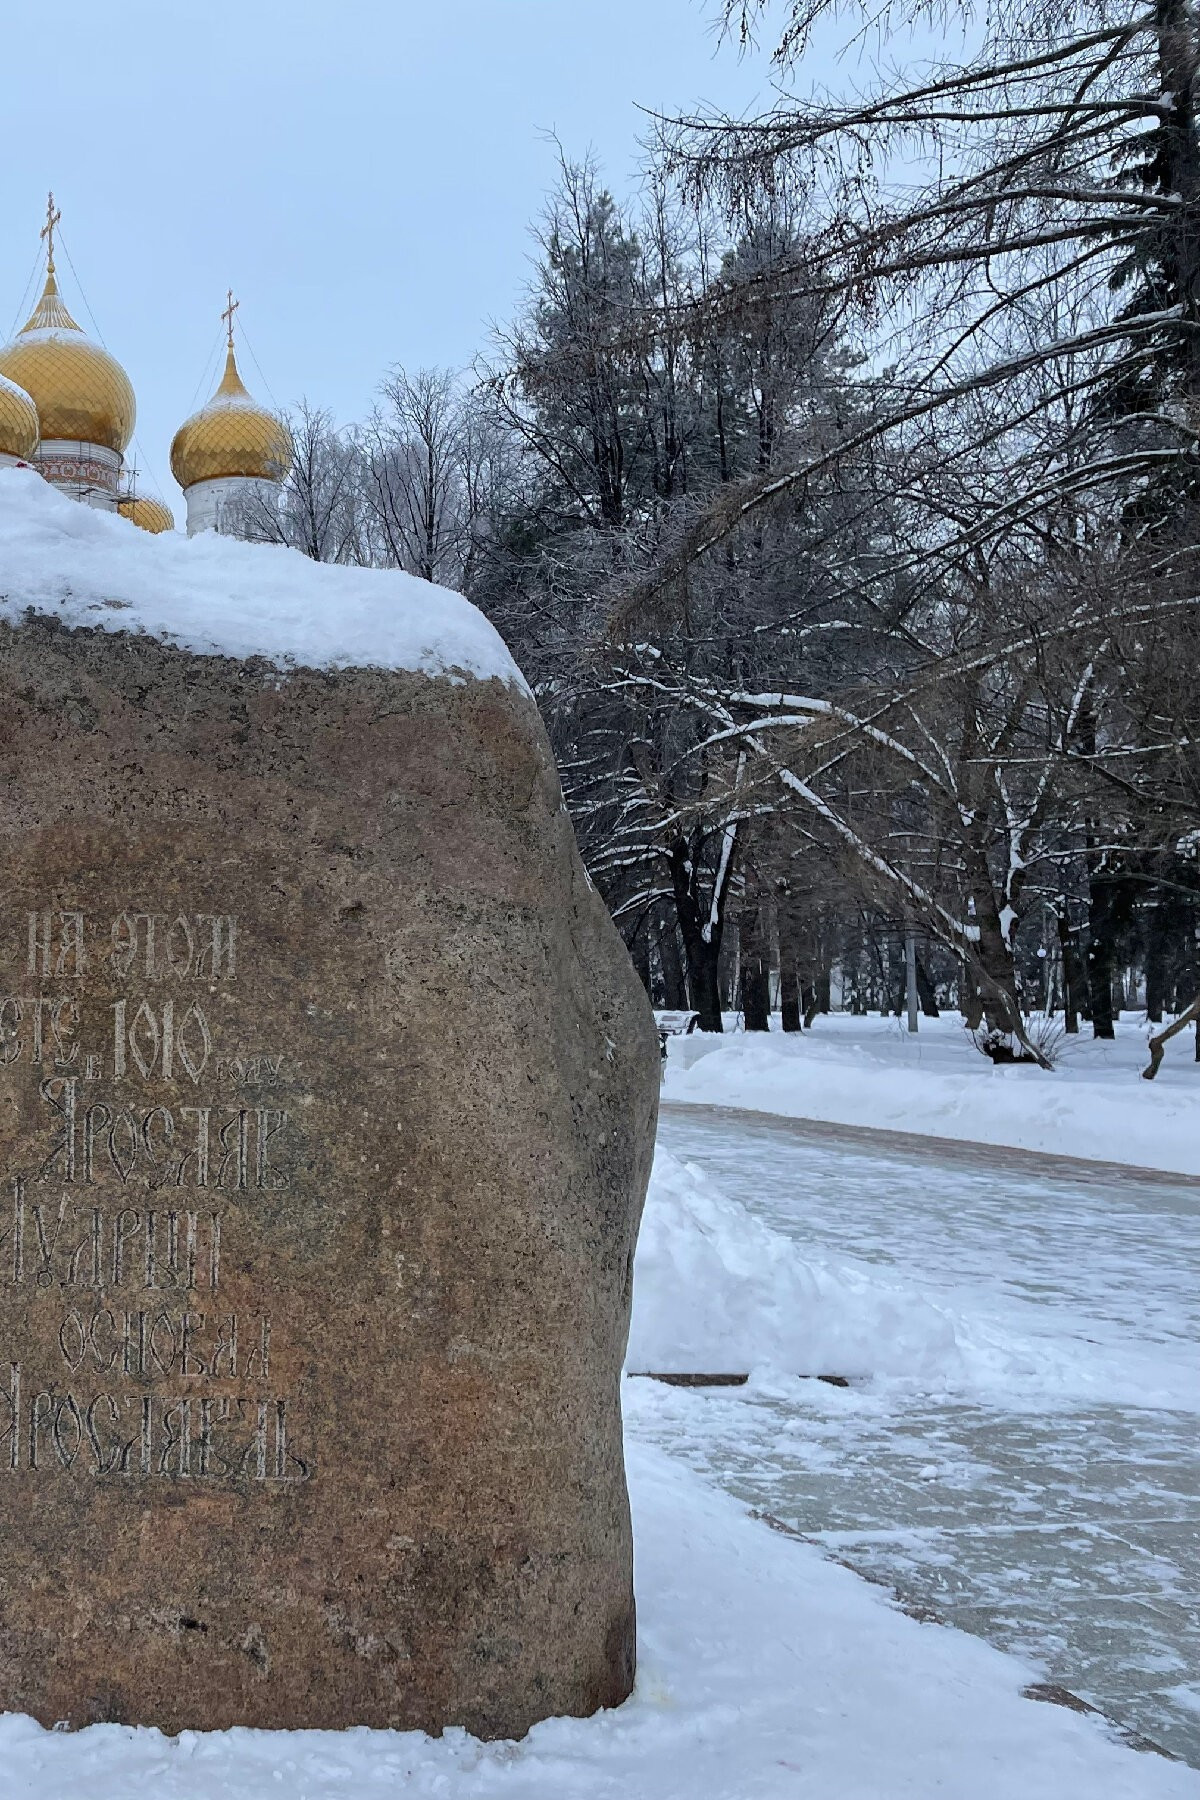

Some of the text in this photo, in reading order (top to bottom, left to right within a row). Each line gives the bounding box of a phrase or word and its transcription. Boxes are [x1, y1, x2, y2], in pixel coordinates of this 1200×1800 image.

[26, 911, 238, 981] НА ЭТОМ
[109, 998, 212, 1084] 1010
